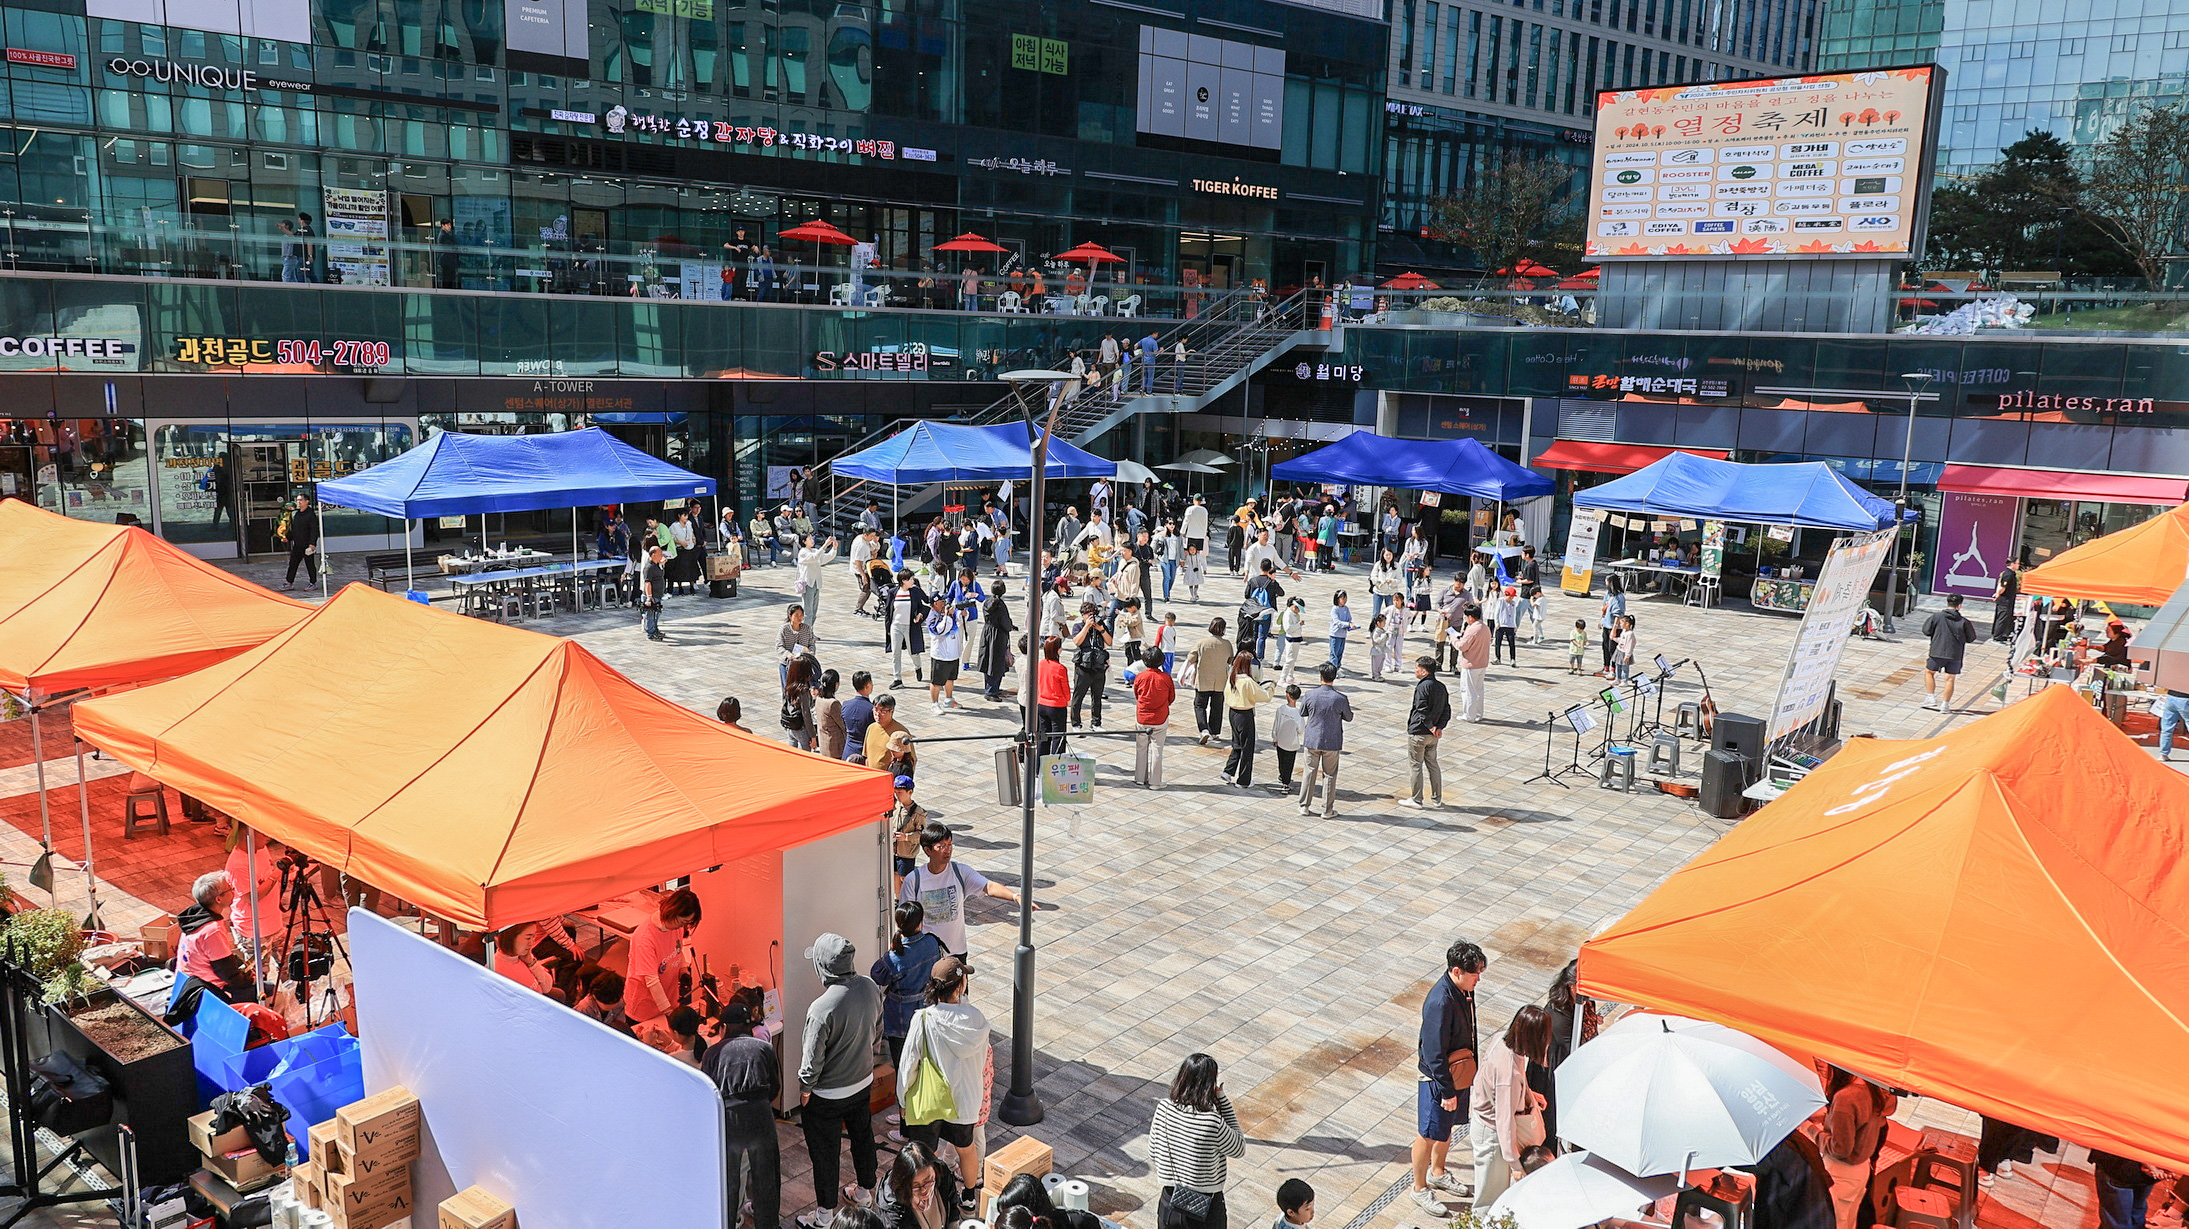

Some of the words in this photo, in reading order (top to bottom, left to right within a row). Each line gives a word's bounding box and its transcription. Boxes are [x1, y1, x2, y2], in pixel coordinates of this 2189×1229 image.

[520, 15, 549, 25] CAFETERIA
[522, 6, 547, 15] PREMIUM
[9, 51, 27, 60] 100%
[1016, 38, 1035, 53] 아침
[1045, 42, 1064, 58] 식사
[1016, 53, 1035, 68] 저녁
[1044, 57, 1064, 73] 가능
[154, 59, 258, 91] UNIQUE
[268, 79, 311, 91] eyewear
[1716, 98, 1760, 110] 마음을
[1845, 91, 1895, 101] 나누는
[630, 113, 671, 134] 행복한
[778, 133, 789, 145] &
[790, 132, 853, 154] 직화구이
[1662, 171, 1711, 179] ROOSTER
[1789, 169, 1825, 178] COFFEE
[1192, 178, 1230, 195] TIGER
[1232, 182, 1278, 200] KOFFEE
[999, 251, 1020, 276] COFFEE
[0, 337, 125, 358] COFFEE
[177, 337, 274, 367] 과천골드
[277, 339, 391, 366] 504-2789
[842, 353, 928, 372] 스마트델리
[1316, 363, 1364, 382] 월미당
[533, 381, 594, 392] A-TOWER
[1051, 764, 1080, 776] 우유팩
